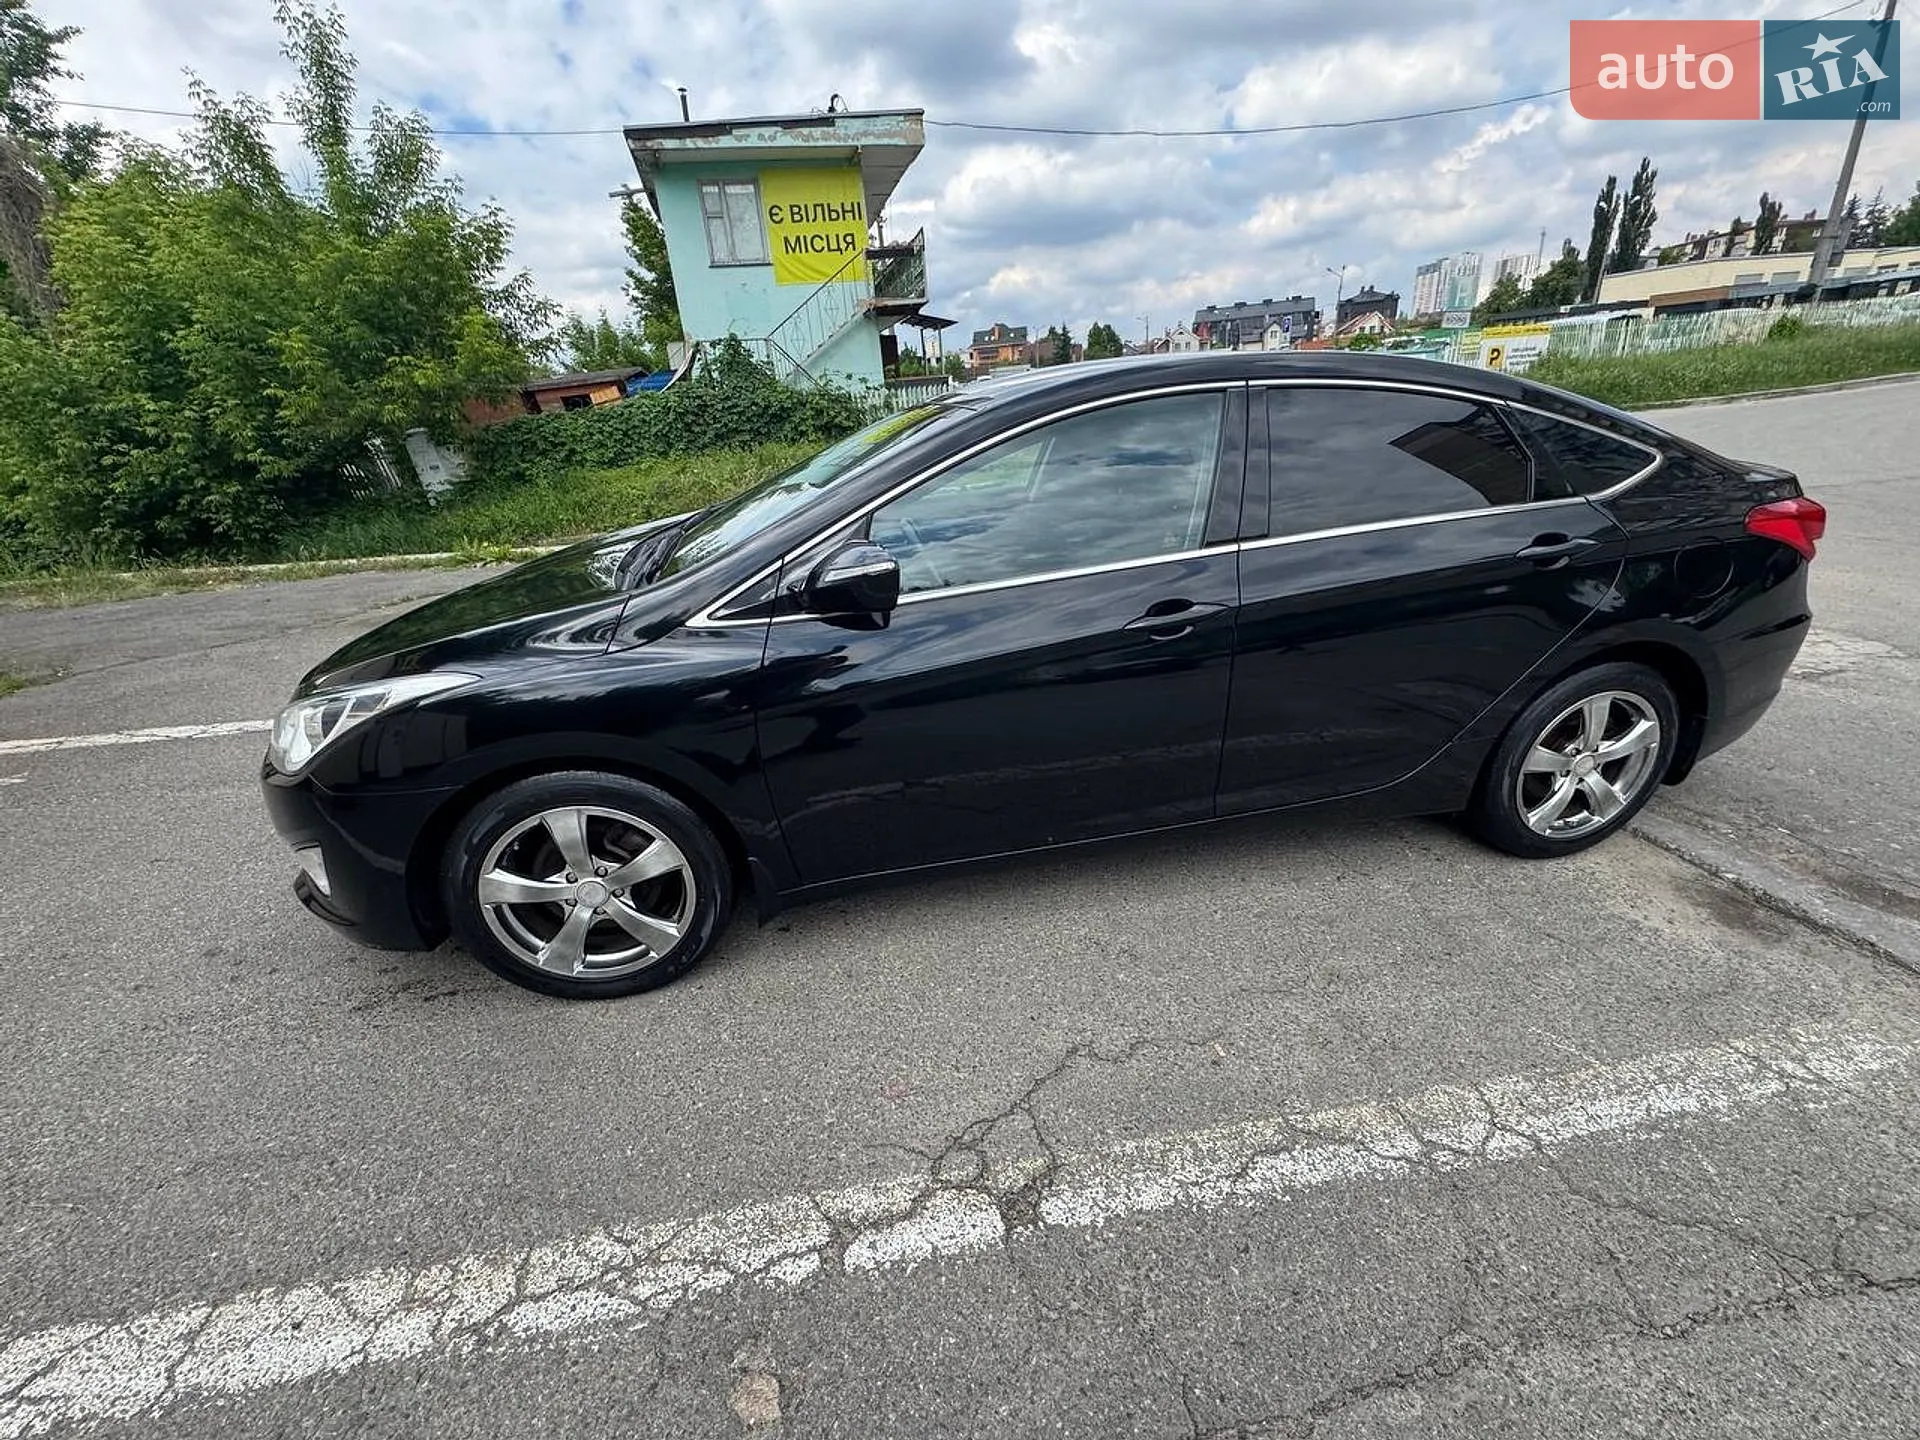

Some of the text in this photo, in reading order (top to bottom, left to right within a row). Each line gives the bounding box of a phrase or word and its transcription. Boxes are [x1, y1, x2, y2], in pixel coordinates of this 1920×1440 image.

[768, 202, 862, 224] Є ВІЛЬНІ
[783, 233, 856, 255] МІСЦЯ
